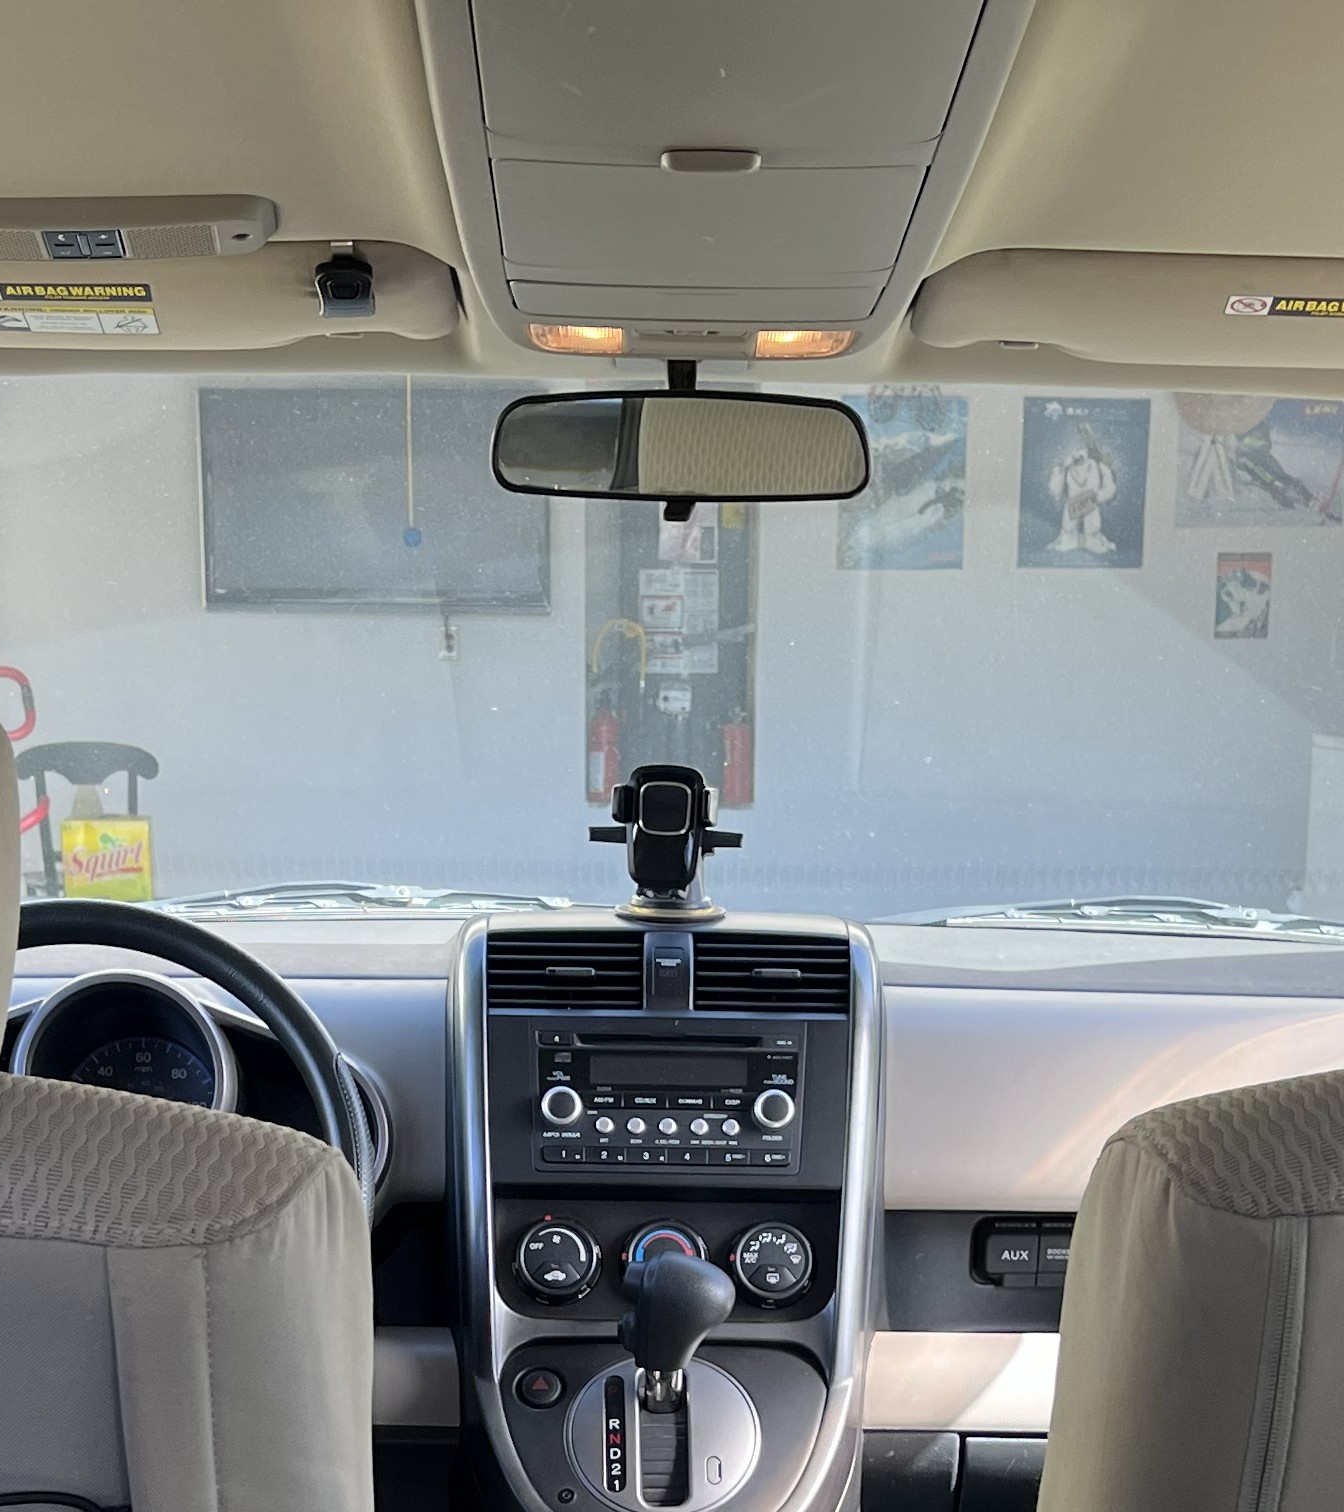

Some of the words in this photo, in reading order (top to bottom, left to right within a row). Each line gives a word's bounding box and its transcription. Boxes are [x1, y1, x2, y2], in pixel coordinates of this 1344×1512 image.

[70, 286, 146, 296] WARNING
[70, 841, 143, 882] Squirt
[135, 1052, 152, 1063] 60
[97, 1066, 114, 1077] 40
[171, 1068, 187, 1080] 80
[600, 1150, 608, 1159] 2
[642, 1151, 650, 1160] 3
[684, 1152, 691, 1161] 4
[725, 1153, 732, 1162] 5
[764, 1153, 771, 1162] 6
[529, 1242, 544, 1250] OFF
[1001, 1250, 1029, 1261] AUX
[609, 1418, 620, 1430] R
[609, 1433, 621, 1445] N
[609, 1448, 621, 1459] D
[611, 1463, 622, 1475] 2
[613, 1480, 620, 1491] 1
